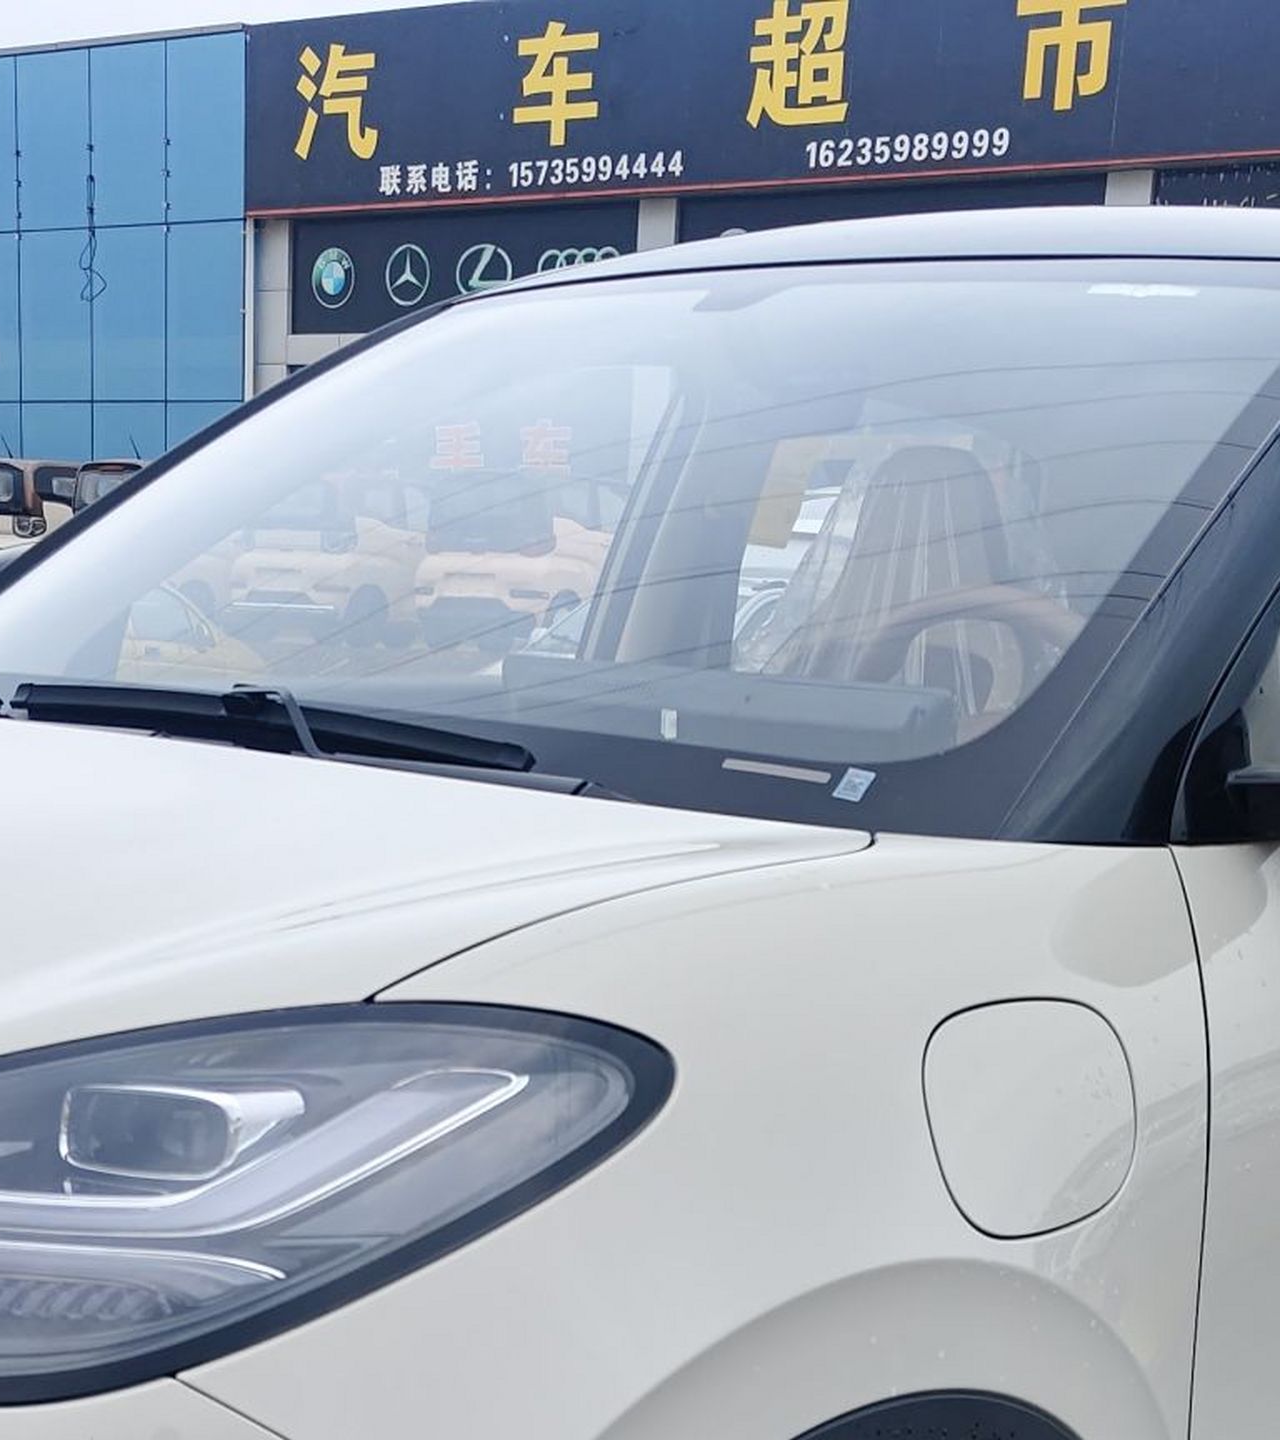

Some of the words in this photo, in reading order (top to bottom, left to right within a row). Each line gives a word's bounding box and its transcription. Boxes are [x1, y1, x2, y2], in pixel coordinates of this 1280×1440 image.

[294, 0, 1128, 160] 汽车超市
[508, 150, 685, 188] 15735994444
[805, 127, 1011, 169] 16235989999
